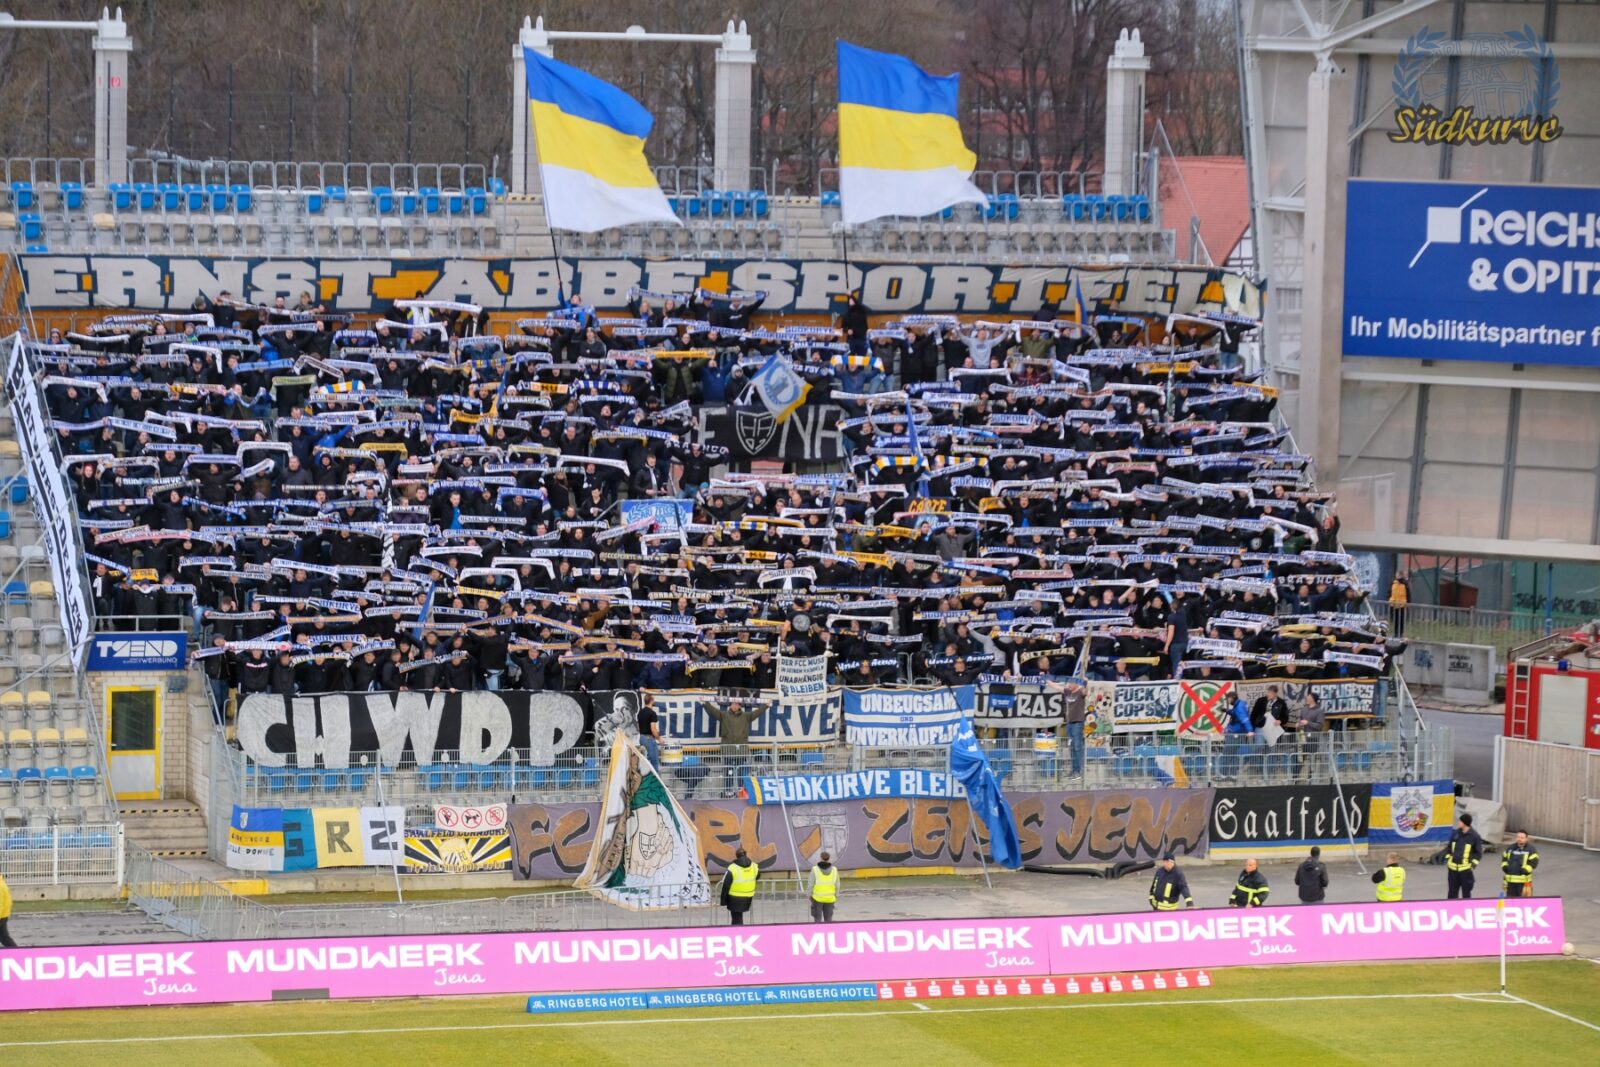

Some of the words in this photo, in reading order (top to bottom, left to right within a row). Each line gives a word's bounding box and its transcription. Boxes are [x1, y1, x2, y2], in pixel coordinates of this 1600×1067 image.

[21, 257, 393, 311] ERNST
[428, 259, 706, 311] ABBE
[1469, 258, 1499, 292] &
[1351, 315, 1382, 337] Ihr
[1388, 318, 1585, 349] Mobilitätspartner
[790, 684, 824, 693] BLEIBEN
[1114, 688, 1155, 702] FUCK
[655, 697, 842, 741] SÜDURVE
[860, 694, 957, 714] UNBEUGSAM
[1114, 703, 1155, 717] COPS
[762, 770, 890, 802] SÜDKURVE
[1215, 796, 1362, 840] Saalfeld
[508, 803, 598, 877] FC
[1056, 795, 1208, 861] JENA
[1060, 914, 1296, 948] MUNDWERK
[1321, 906, 1551, 936] MUNDWERK
[514, 934, 763, 966] MUNDWERK
[791, 926, 1034, 956] MUNDWERK
[1248, 939, 1297, 957] Jena
[1506, 930, 1552, 947] Jena
[227, 942, 486, 976] MUNDWERK
[714, 960, 765, 978] Jena
[985, 950, 1035, 969] Jena
[143, 972, 197, 996] Jena
[433, 968, 487, 987] Jena
[548, 998, 607, 1009] RINGBERG
[609, 996, 646, 1007] HOTEL
[664, 994, 723, 1006] RINGBERG
[725, 991, 762, 1002] HOTEL
[780, 988, 839, 1001] RINGBERG
[841, 986, 878, 998] HOTEL
